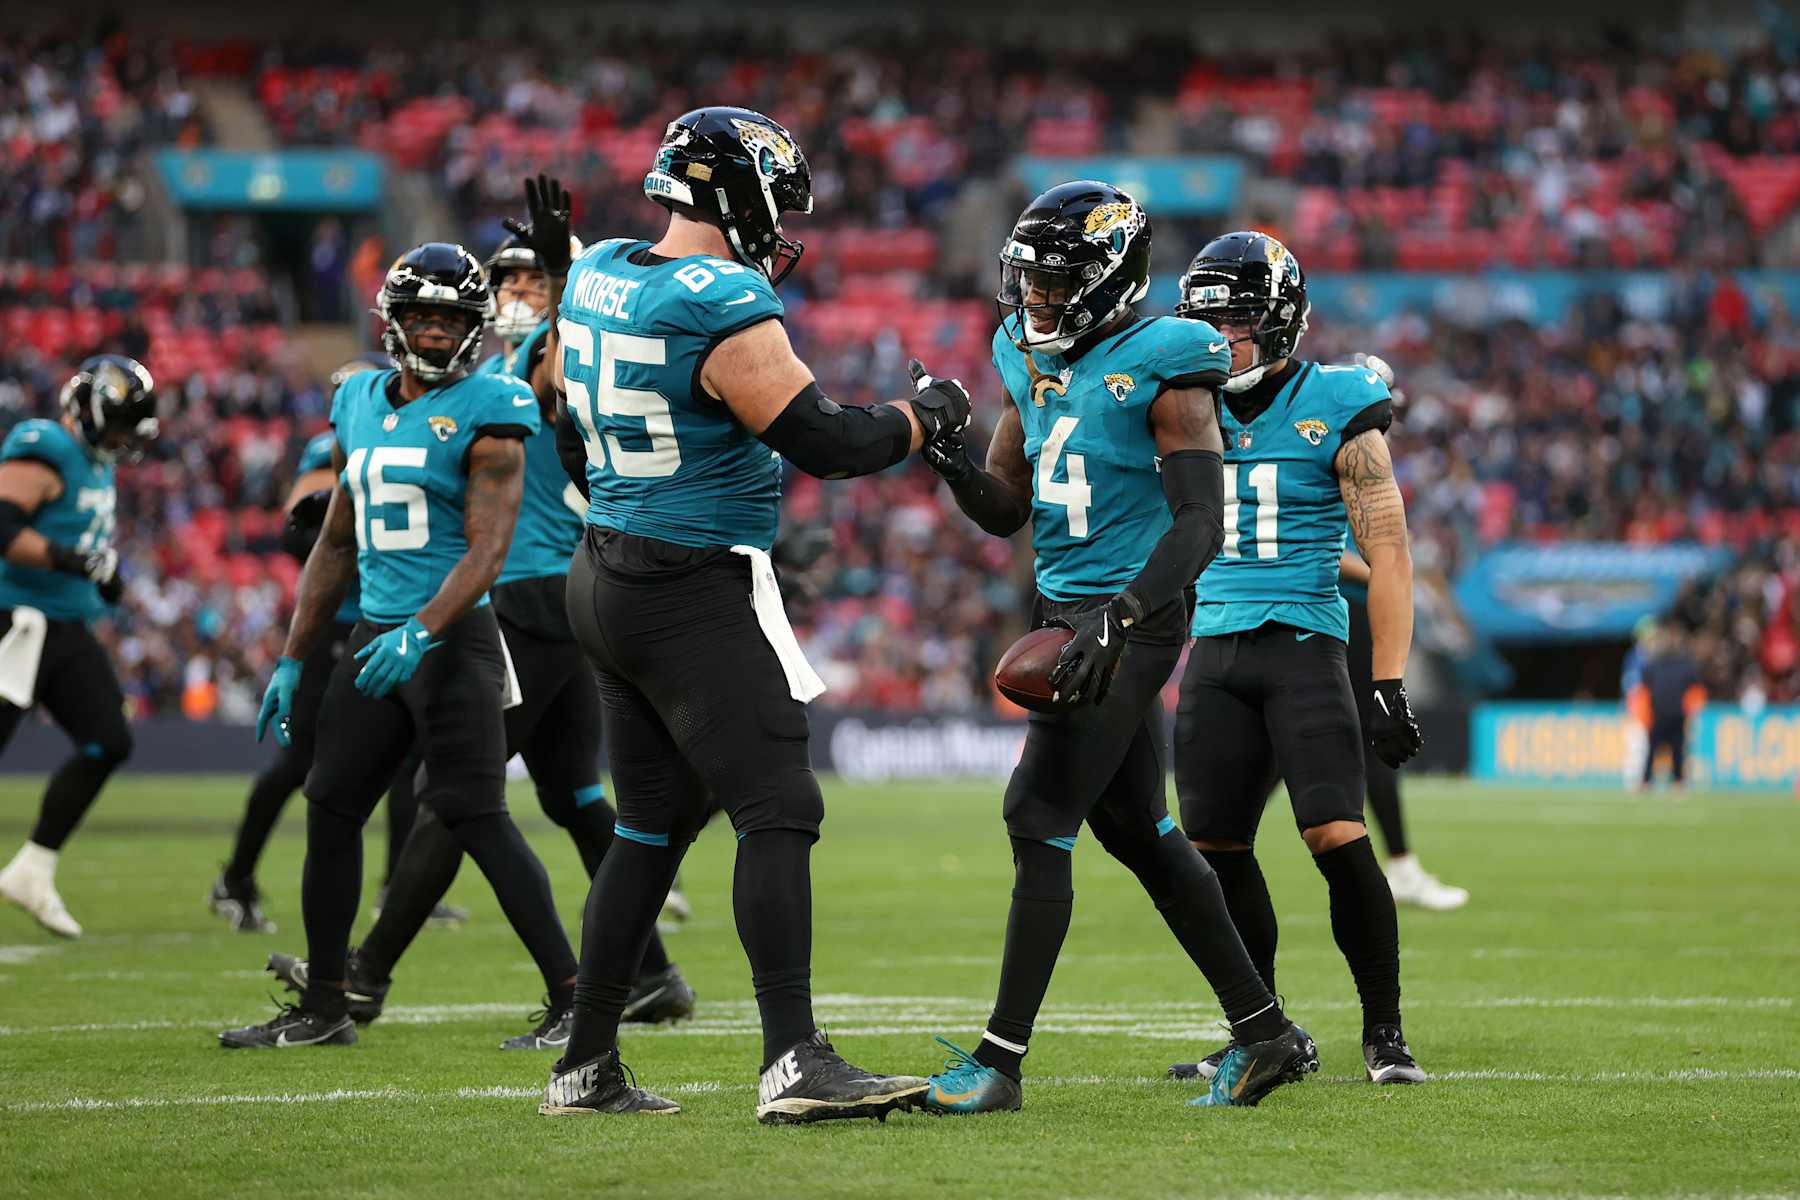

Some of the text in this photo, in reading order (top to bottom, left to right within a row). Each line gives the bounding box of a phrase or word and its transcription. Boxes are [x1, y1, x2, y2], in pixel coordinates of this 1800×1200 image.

[572, 268, 641, 320] MORSE
[557, 317, 682, 478] 65
[346, 446, 430, 552] 15
[1038, 416, 1092, 538] 4
[548, 1063, 600, 1107] NIKE
[758, 1050, 802, 1106] NIKE
